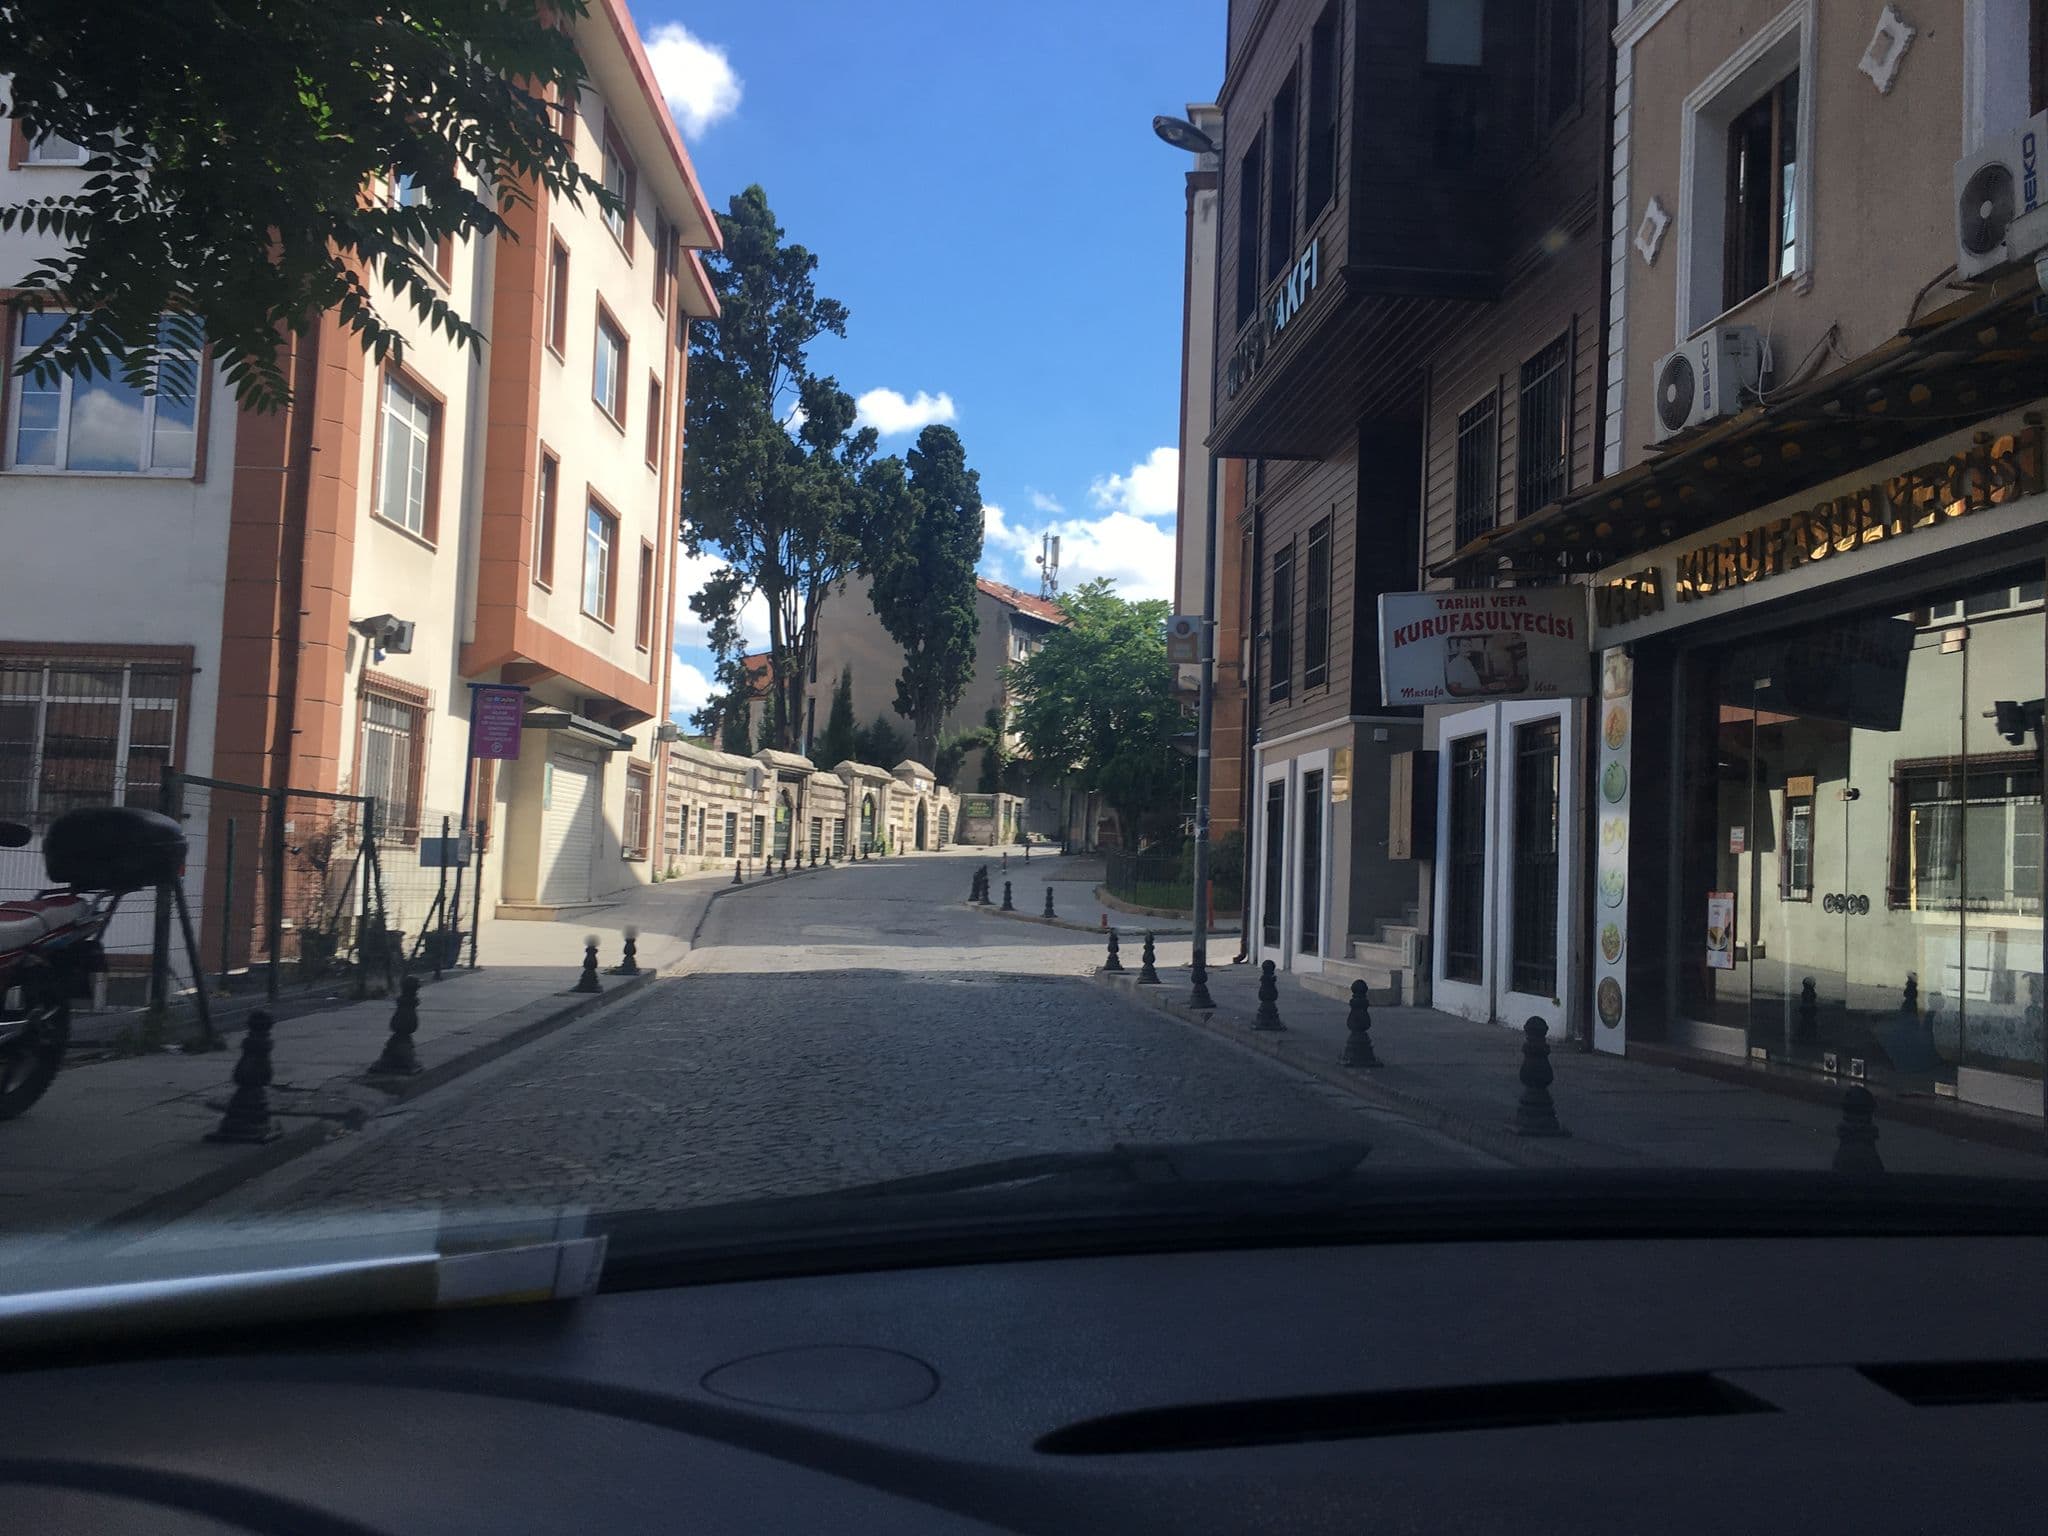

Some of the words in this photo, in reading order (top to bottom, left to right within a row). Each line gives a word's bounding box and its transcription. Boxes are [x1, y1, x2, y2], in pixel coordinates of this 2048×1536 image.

[1702, 340, 1712, 410] BEKO
[1436, 595, 1485, 609] TARİHİ
[1490, 595, 1527, 609] VEFA
[1597, 567, 1665, 628] VEFA
[1393, 610, 1575, 649] KURUFASULYECİSİ
[1400, 685, 1445, 698] Mustafa
